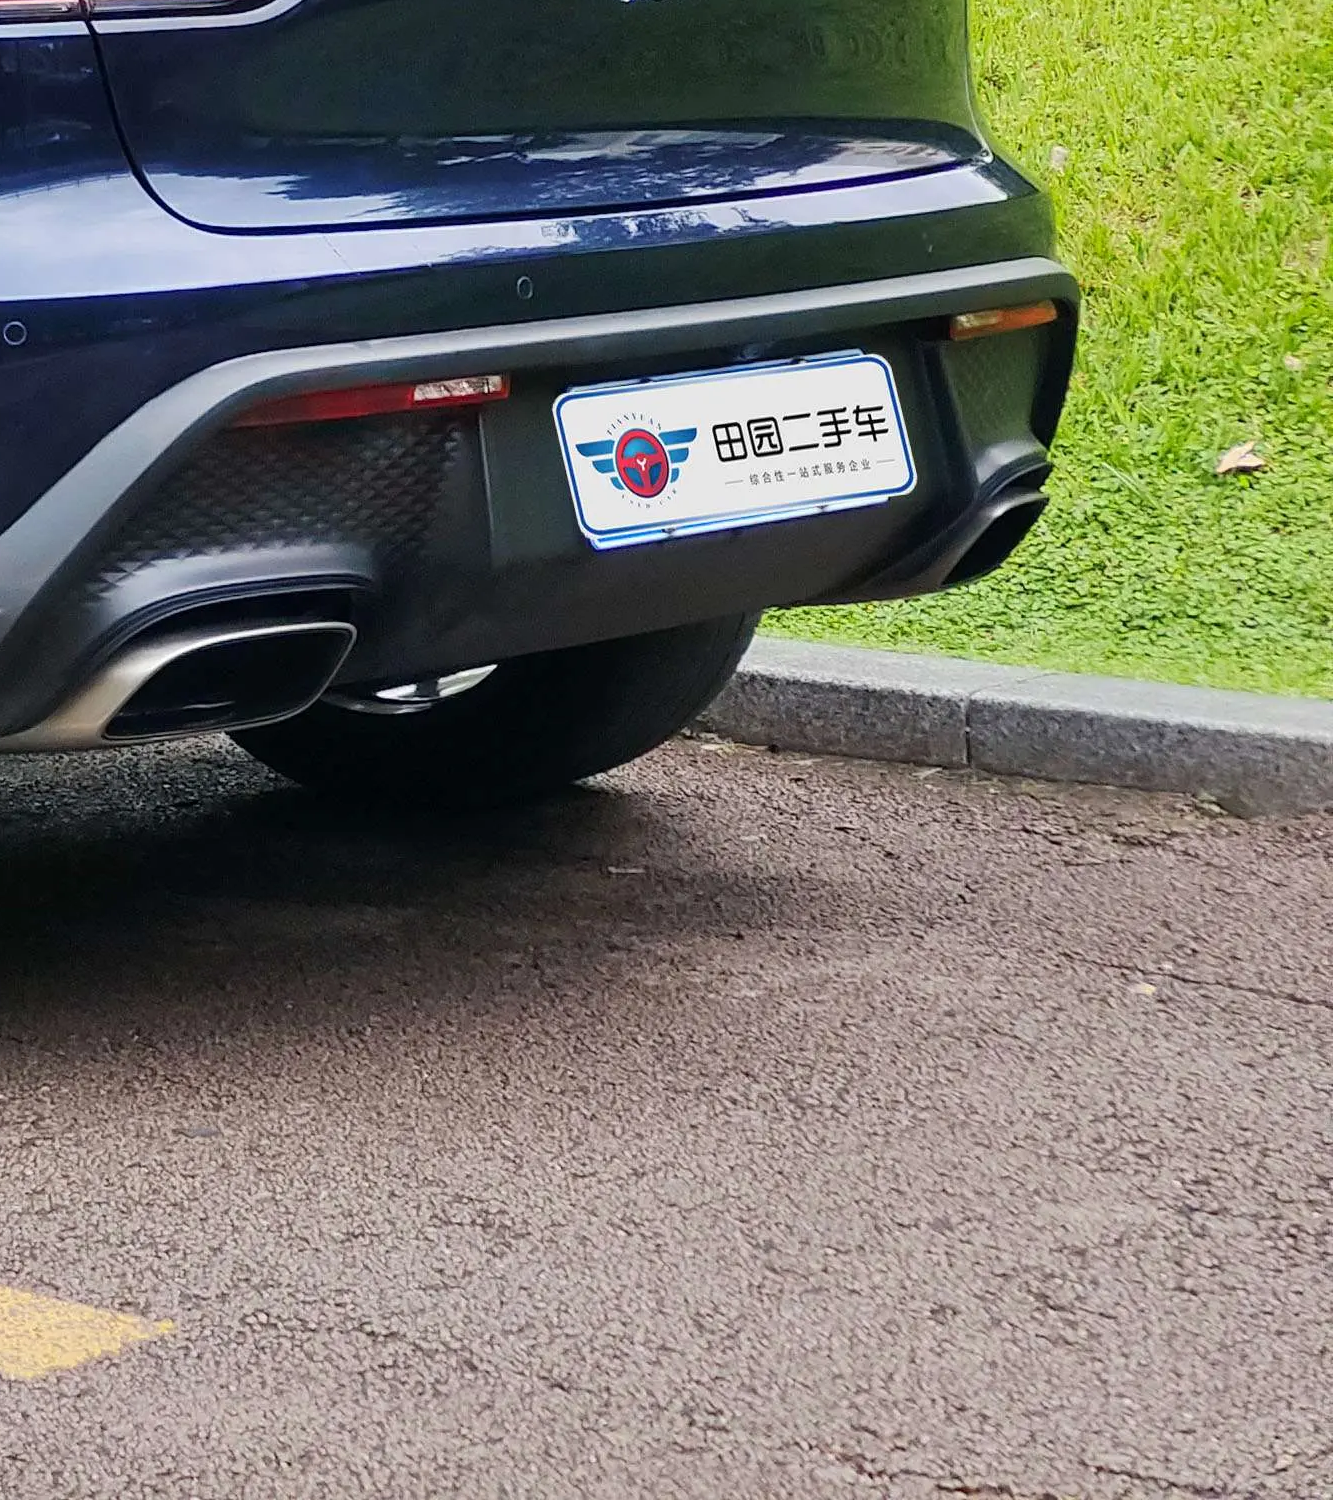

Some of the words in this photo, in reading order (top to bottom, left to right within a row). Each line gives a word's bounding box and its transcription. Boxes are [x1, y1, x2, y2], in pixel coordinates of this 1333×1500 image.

[712, 405, 889, 463] 田园二手车
[749, 459, 871, 486] 综合性一站式服务企业
